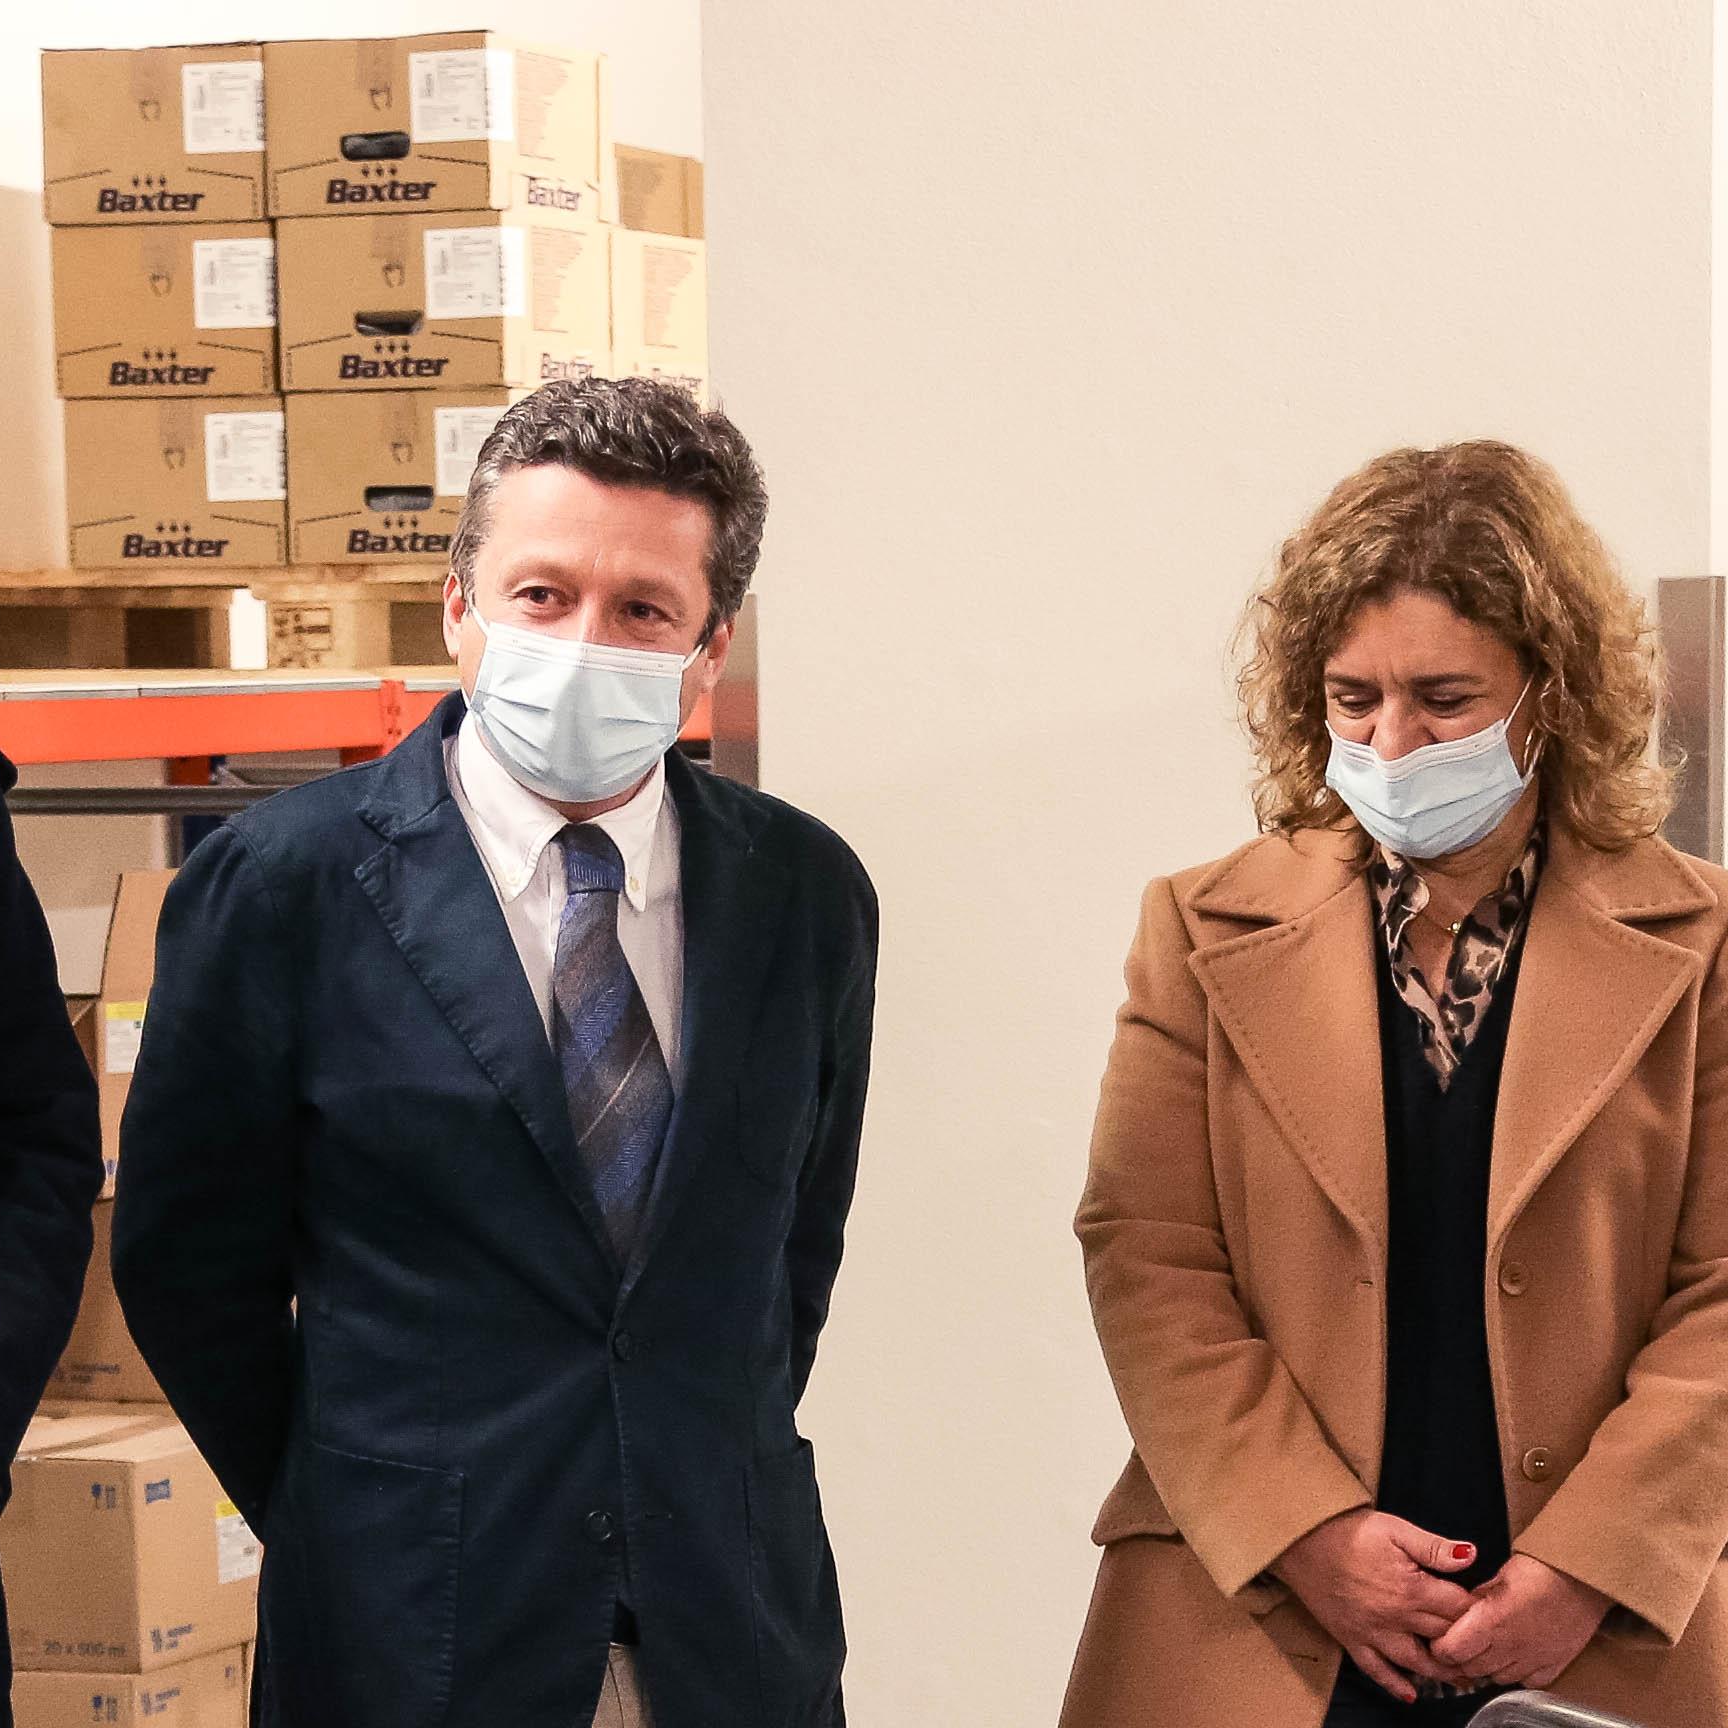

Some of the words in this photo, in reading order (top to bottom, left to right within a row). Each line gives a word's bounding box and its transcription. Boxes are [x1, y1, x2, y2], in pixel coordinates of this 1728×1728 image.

[97, 187, 205, 215] Baxter
[326, 177, 437, 206] Baxter
[527, 176, 581, 211] Baxter
[109, 360, 214, 388] Baxter
[339, 351, 449, 381] Baxter
[122, 532, 229, 559] Baxter
